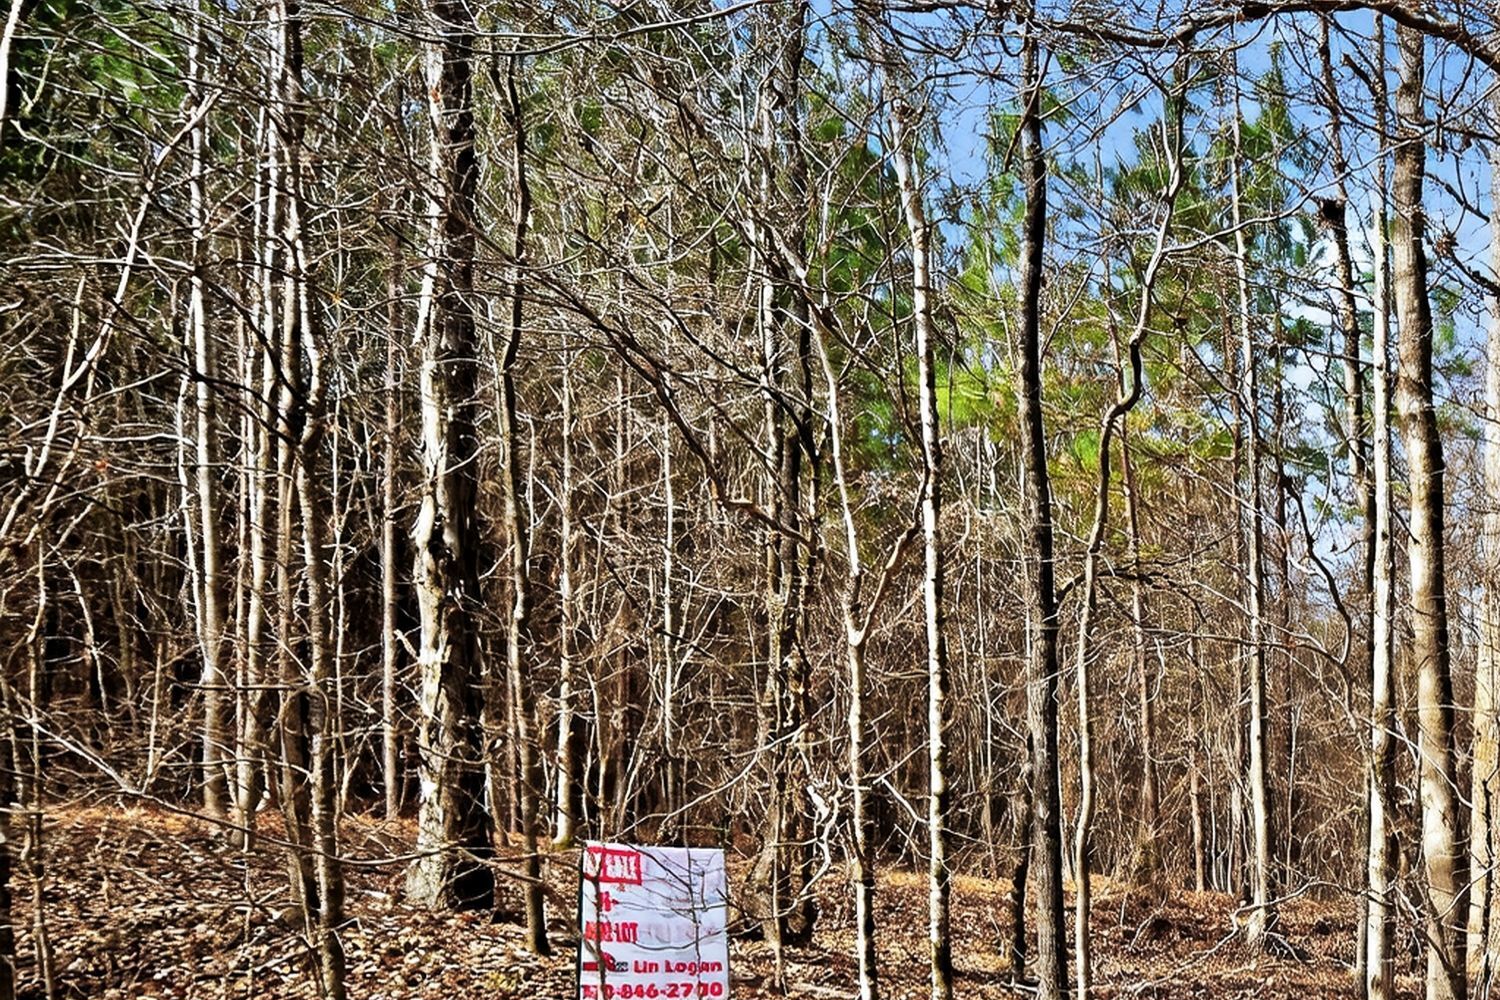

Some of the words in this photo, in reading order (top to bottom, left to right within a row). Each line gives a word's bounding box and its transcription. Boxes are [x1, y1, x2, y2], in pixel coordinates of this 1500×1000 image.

[633, 960, 659, 973] Lin
[664, 960, 723, 976] Logan
[581, 982, 723, 1000] 0-846-2700
